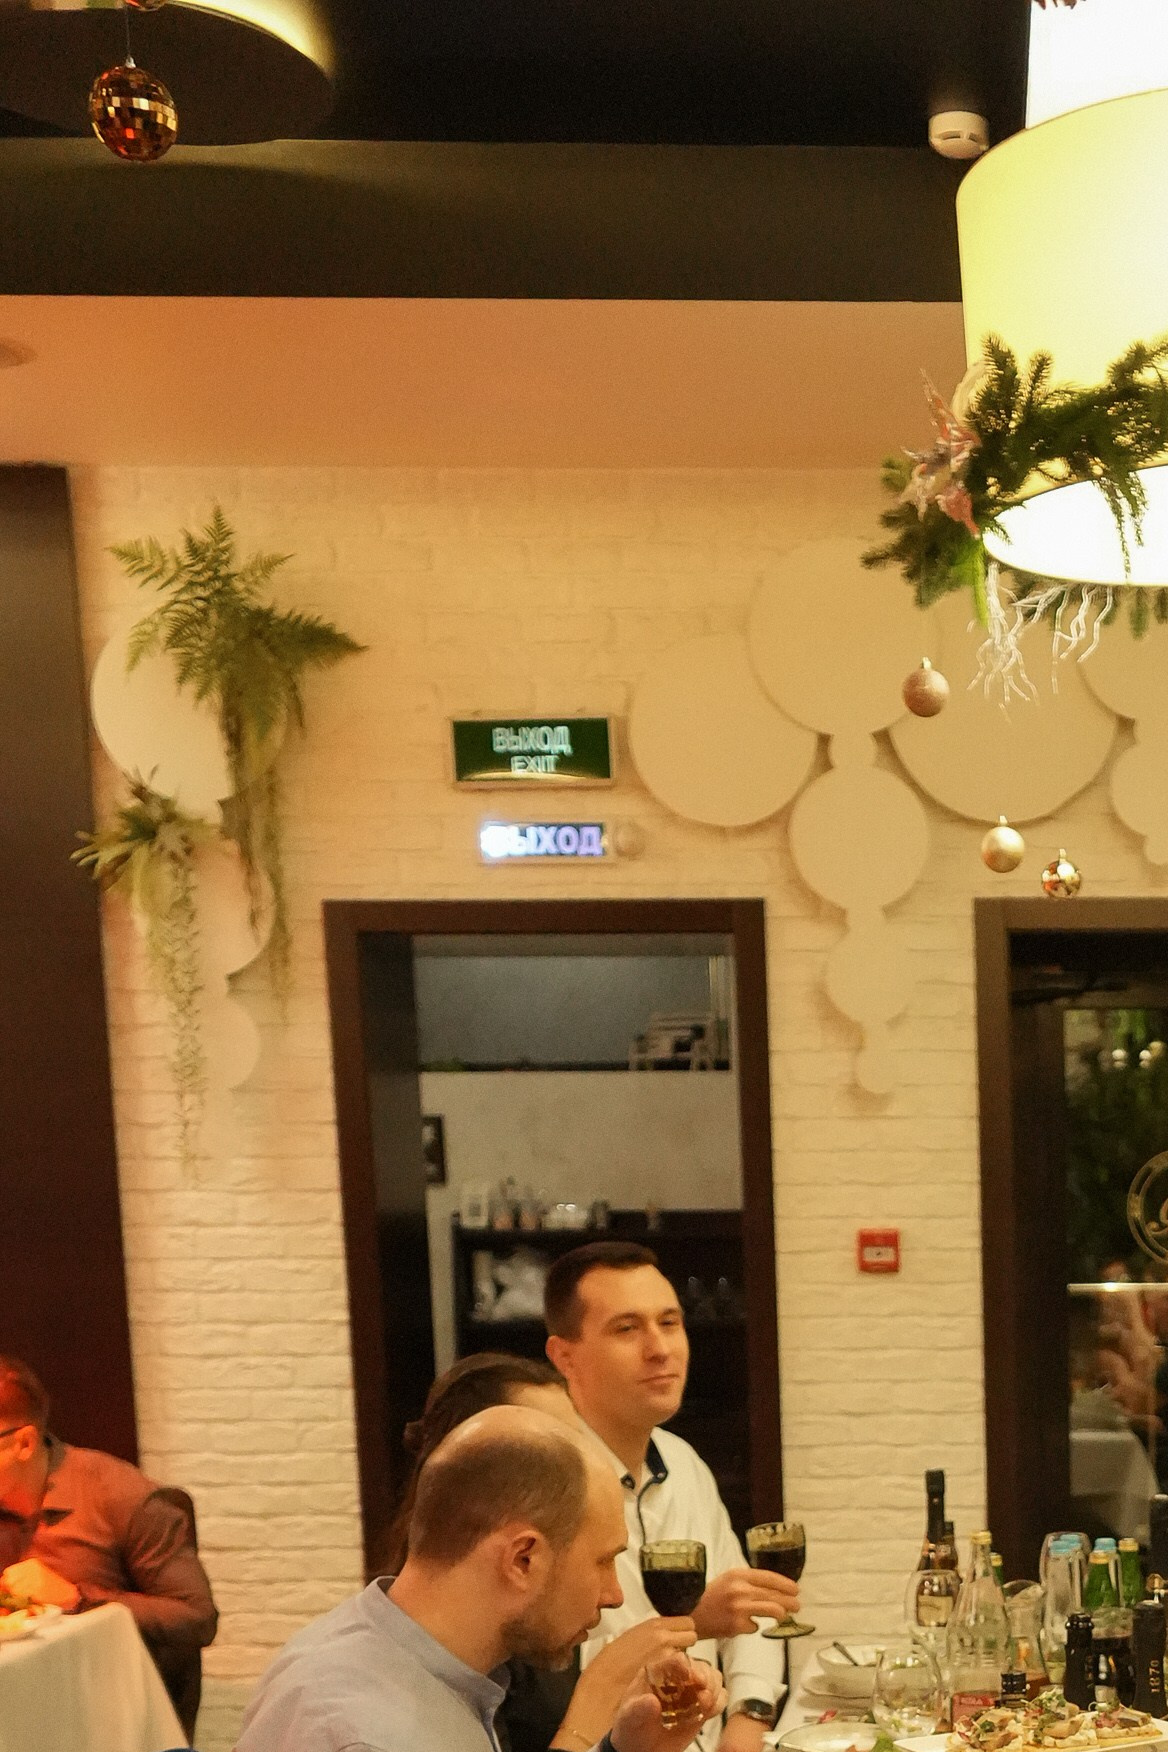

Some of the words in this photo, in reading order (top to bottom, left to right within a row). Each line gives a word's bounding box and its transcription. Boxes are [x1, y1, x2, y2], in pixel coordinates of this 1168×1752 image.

[492, 725, 573, 756] ВЫХОД
[510, 755, 561, 773] EXIT
[1148, 1659, 1161, 1693] 1870
